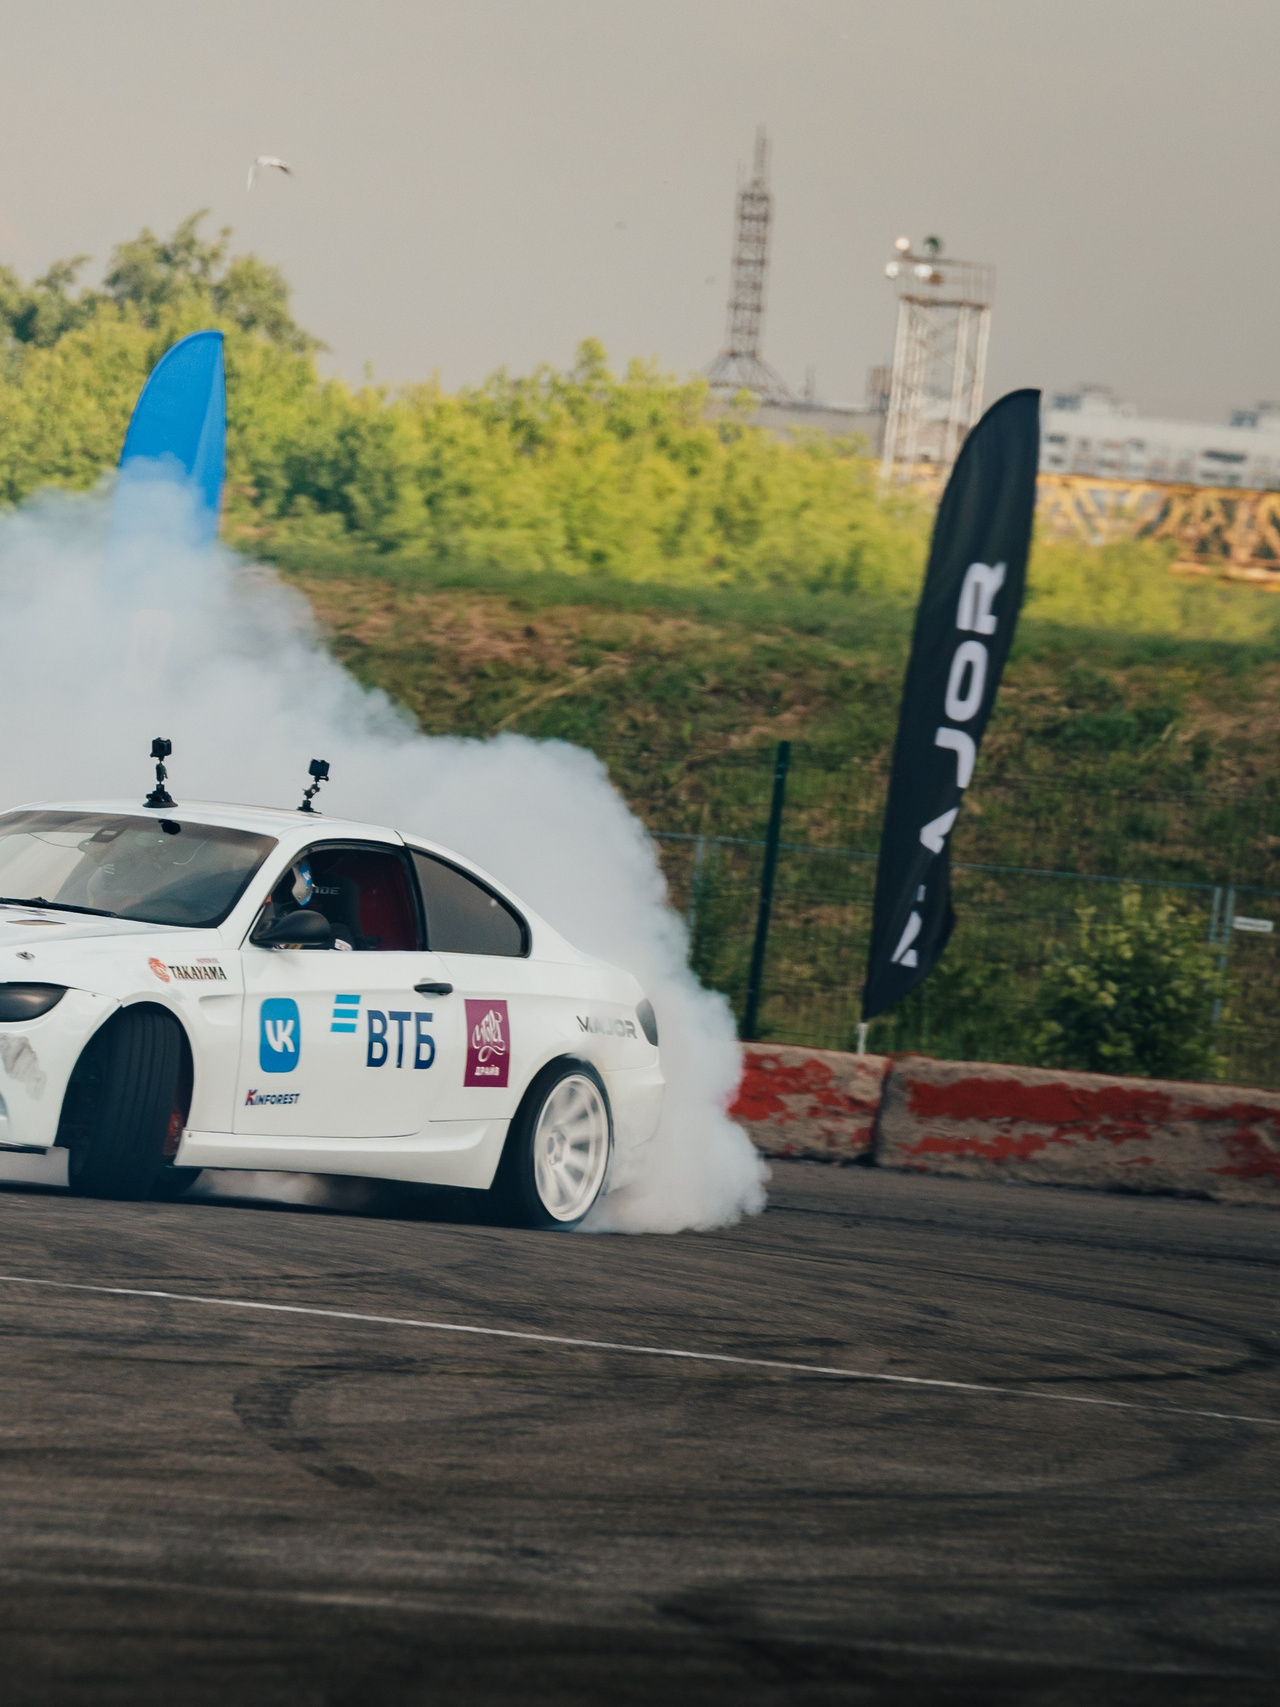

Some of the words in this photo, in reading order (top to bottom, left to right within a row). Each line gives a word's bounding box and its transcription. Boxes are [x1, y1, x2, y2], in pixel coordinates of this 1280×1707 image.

[168, 966, 227, 980] TAKAYAMA
[366, 1010, 436, 1070] ВТБ
[244, 1089, 300, 1106] KINFOREST
